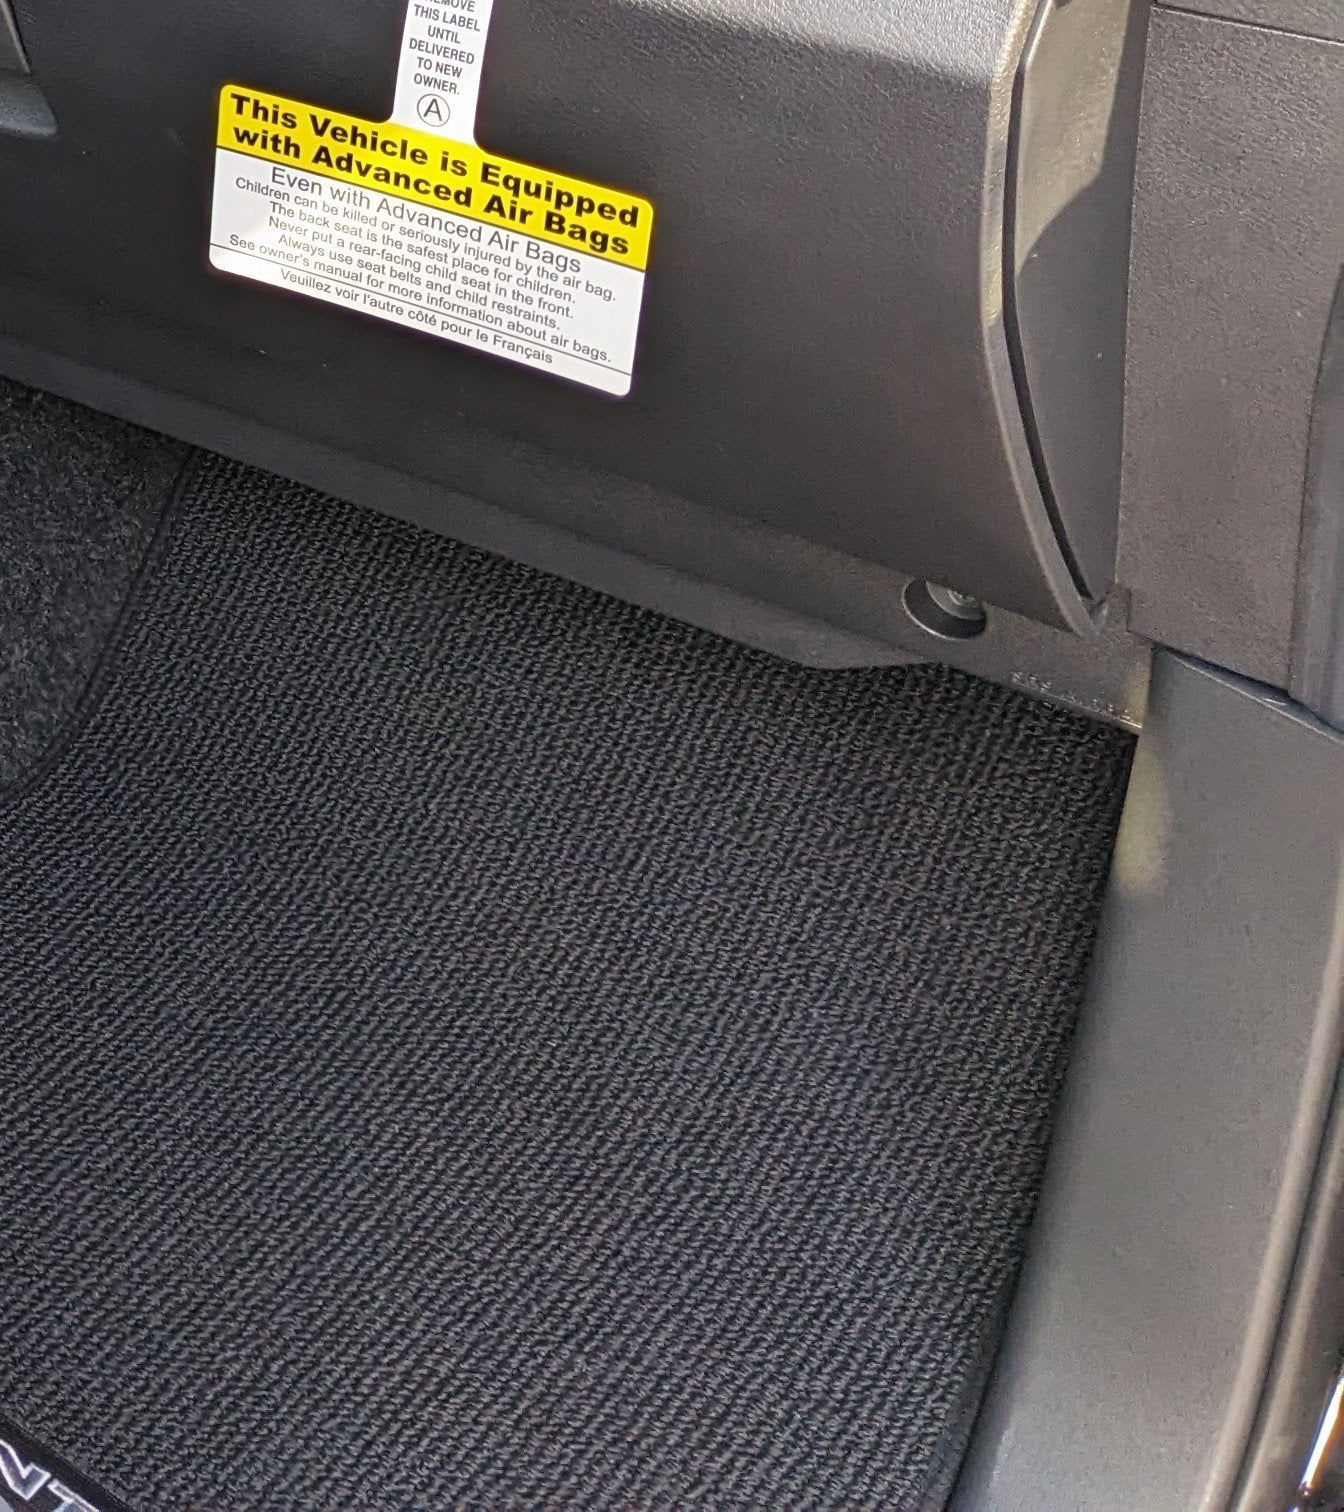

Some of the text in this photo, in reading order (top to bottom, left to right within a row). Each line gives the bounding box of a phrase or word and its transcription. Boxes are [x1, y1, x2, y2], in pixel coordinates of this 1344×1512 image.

[409, 37, 475, 64] DELIVERED
[414, 4, 480, 32] THIS LABEL
[417, 56, 463, 78] TO NEW
[428, 25, 461, 44] UNTIL
[414, 73, 459, 95] OWNER.
[230, 92, 639, 228] This Vehicle is Equipped
[233, 126, 628, 255] with Advanced Air Bags
[235, 176, 616, 302] Children can be killed or seriously injured by the air bag.
[269, 200, 575, 304] The back seat is the safest place for children.
[269, 215, 573, 319] Never put a rear-facing child seat in the front.
[271, 166, 581, 279] Even with Advanced Air Bags
[229, 234, 611, 363] See owner's manual for more information about air bags.
[278, 234, 560, 331] Always use seat belts and child restraints.
[281, 268, 553, 364] Veuillez voir l'autre côté pour le Français
